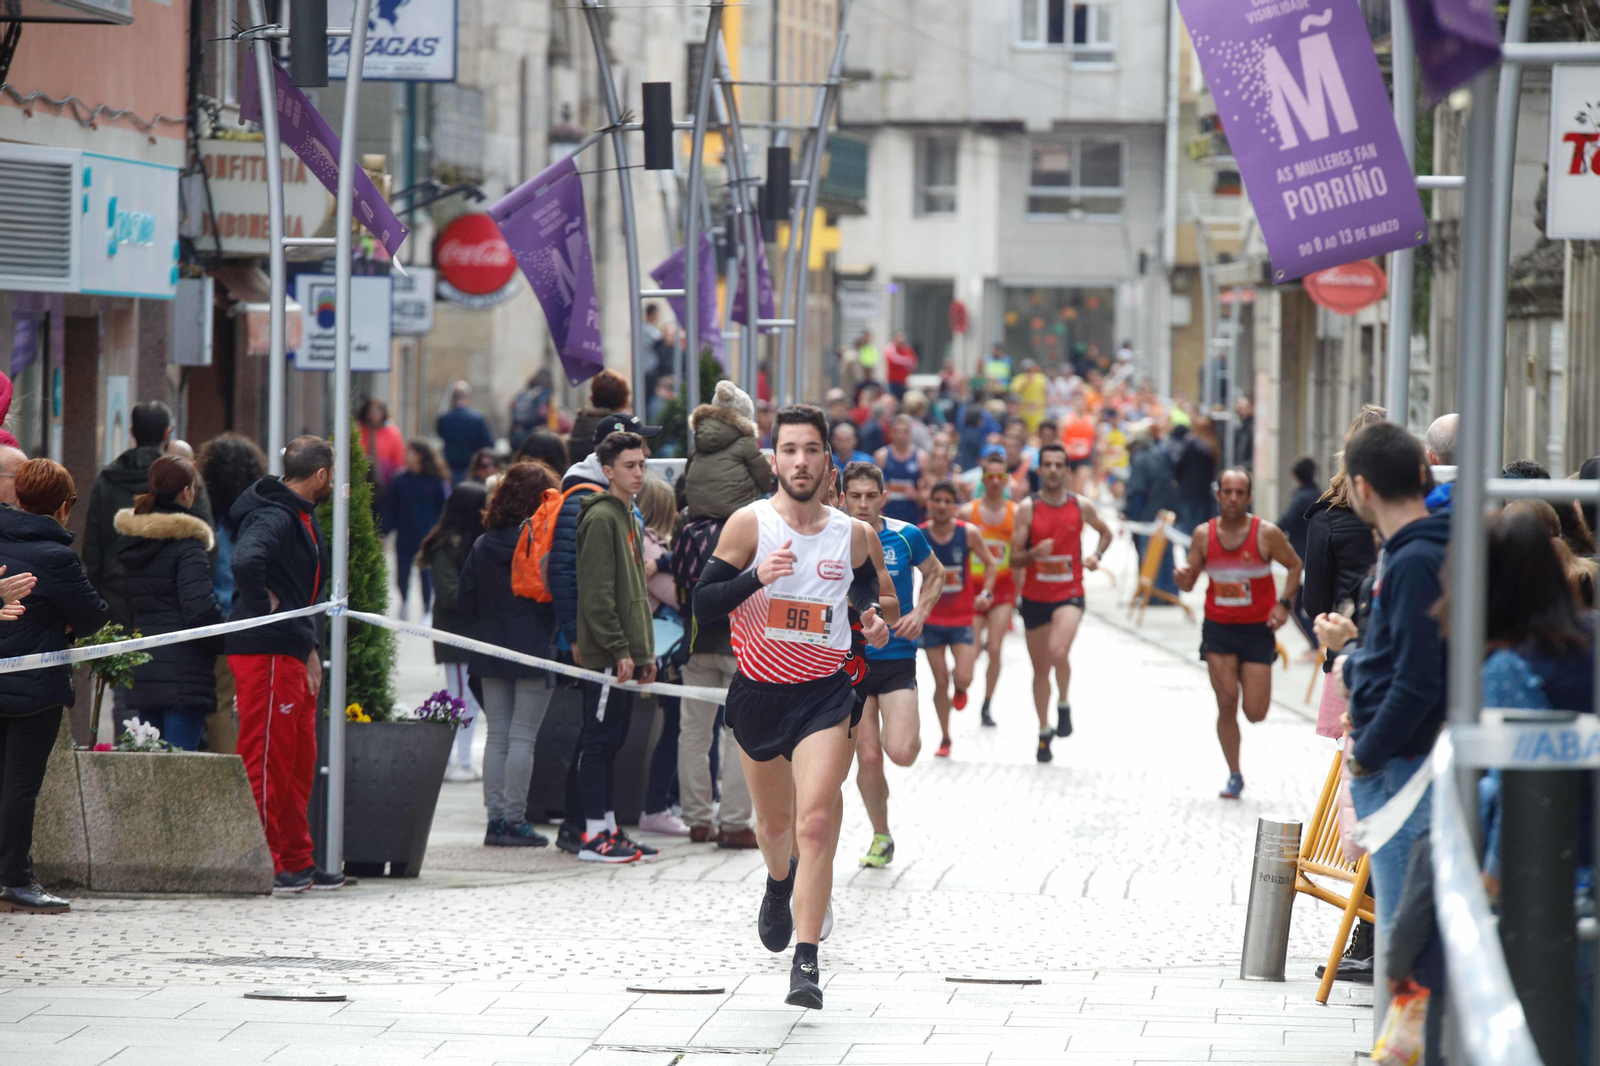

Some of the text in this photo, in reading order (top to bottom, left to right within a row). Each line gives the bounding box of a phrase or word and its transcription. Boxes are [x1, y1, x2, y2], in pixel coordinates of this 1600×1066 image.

[327, 36, 441, 56] RAAGAS
[1276, 142, 1378, 184] AS MULLERES FAN
[1282, 163, 1389, 221] PORRIÑO
[1298, 218, 1400, 257] DO 8 AO 13 DE MARZO
[786, 608, 810, 630] 96
